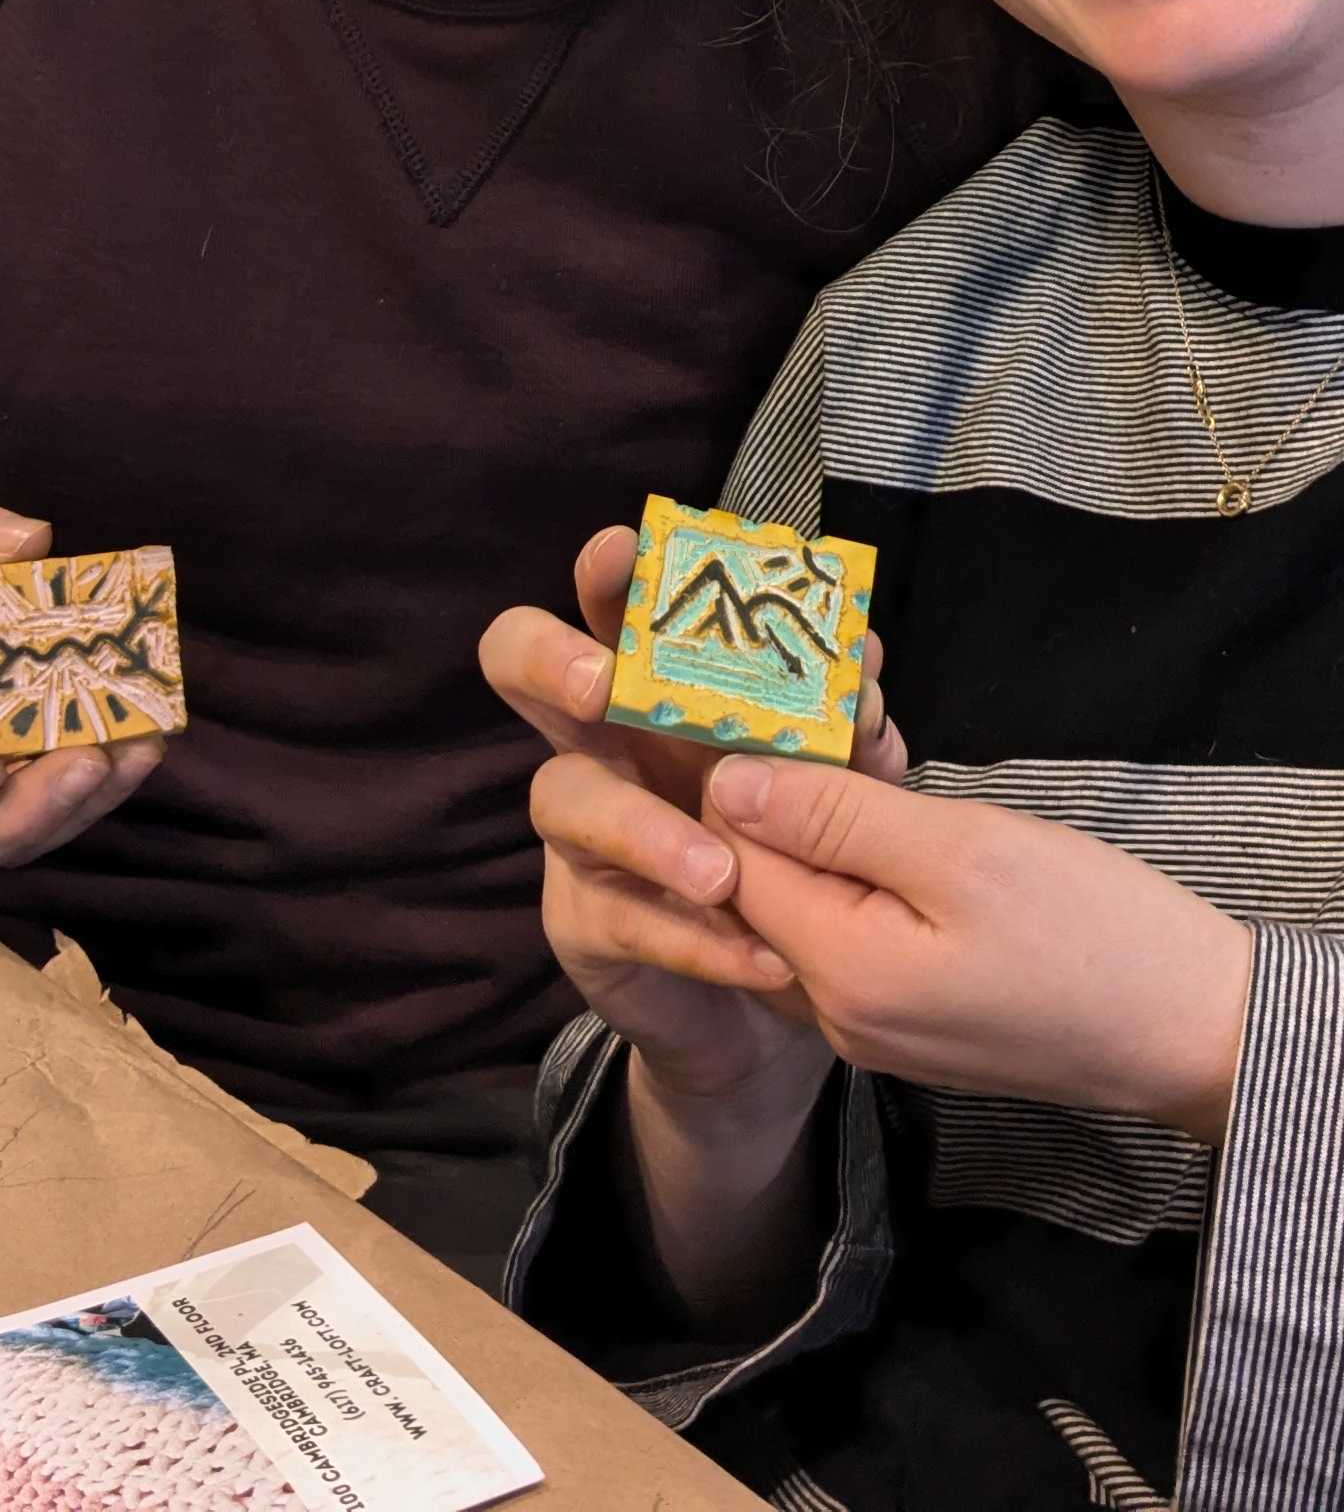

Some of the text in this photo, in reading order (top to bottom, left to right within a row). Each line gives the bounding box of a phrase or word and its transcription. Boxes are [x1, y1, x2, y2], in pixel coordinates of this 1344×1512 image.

[171, 1297, 215, 1334] FLOOR
[204, 1334, 237, 1358] 2ND
[235, 1340, 328, 1437] CAMBRIDGE, MA
[279, 1338, 367, 1421] (617) 945-1436
[241, 1375, 341, 1483] CAMBRIDGESIDE
[331, 1484, 366, 1512] 100
